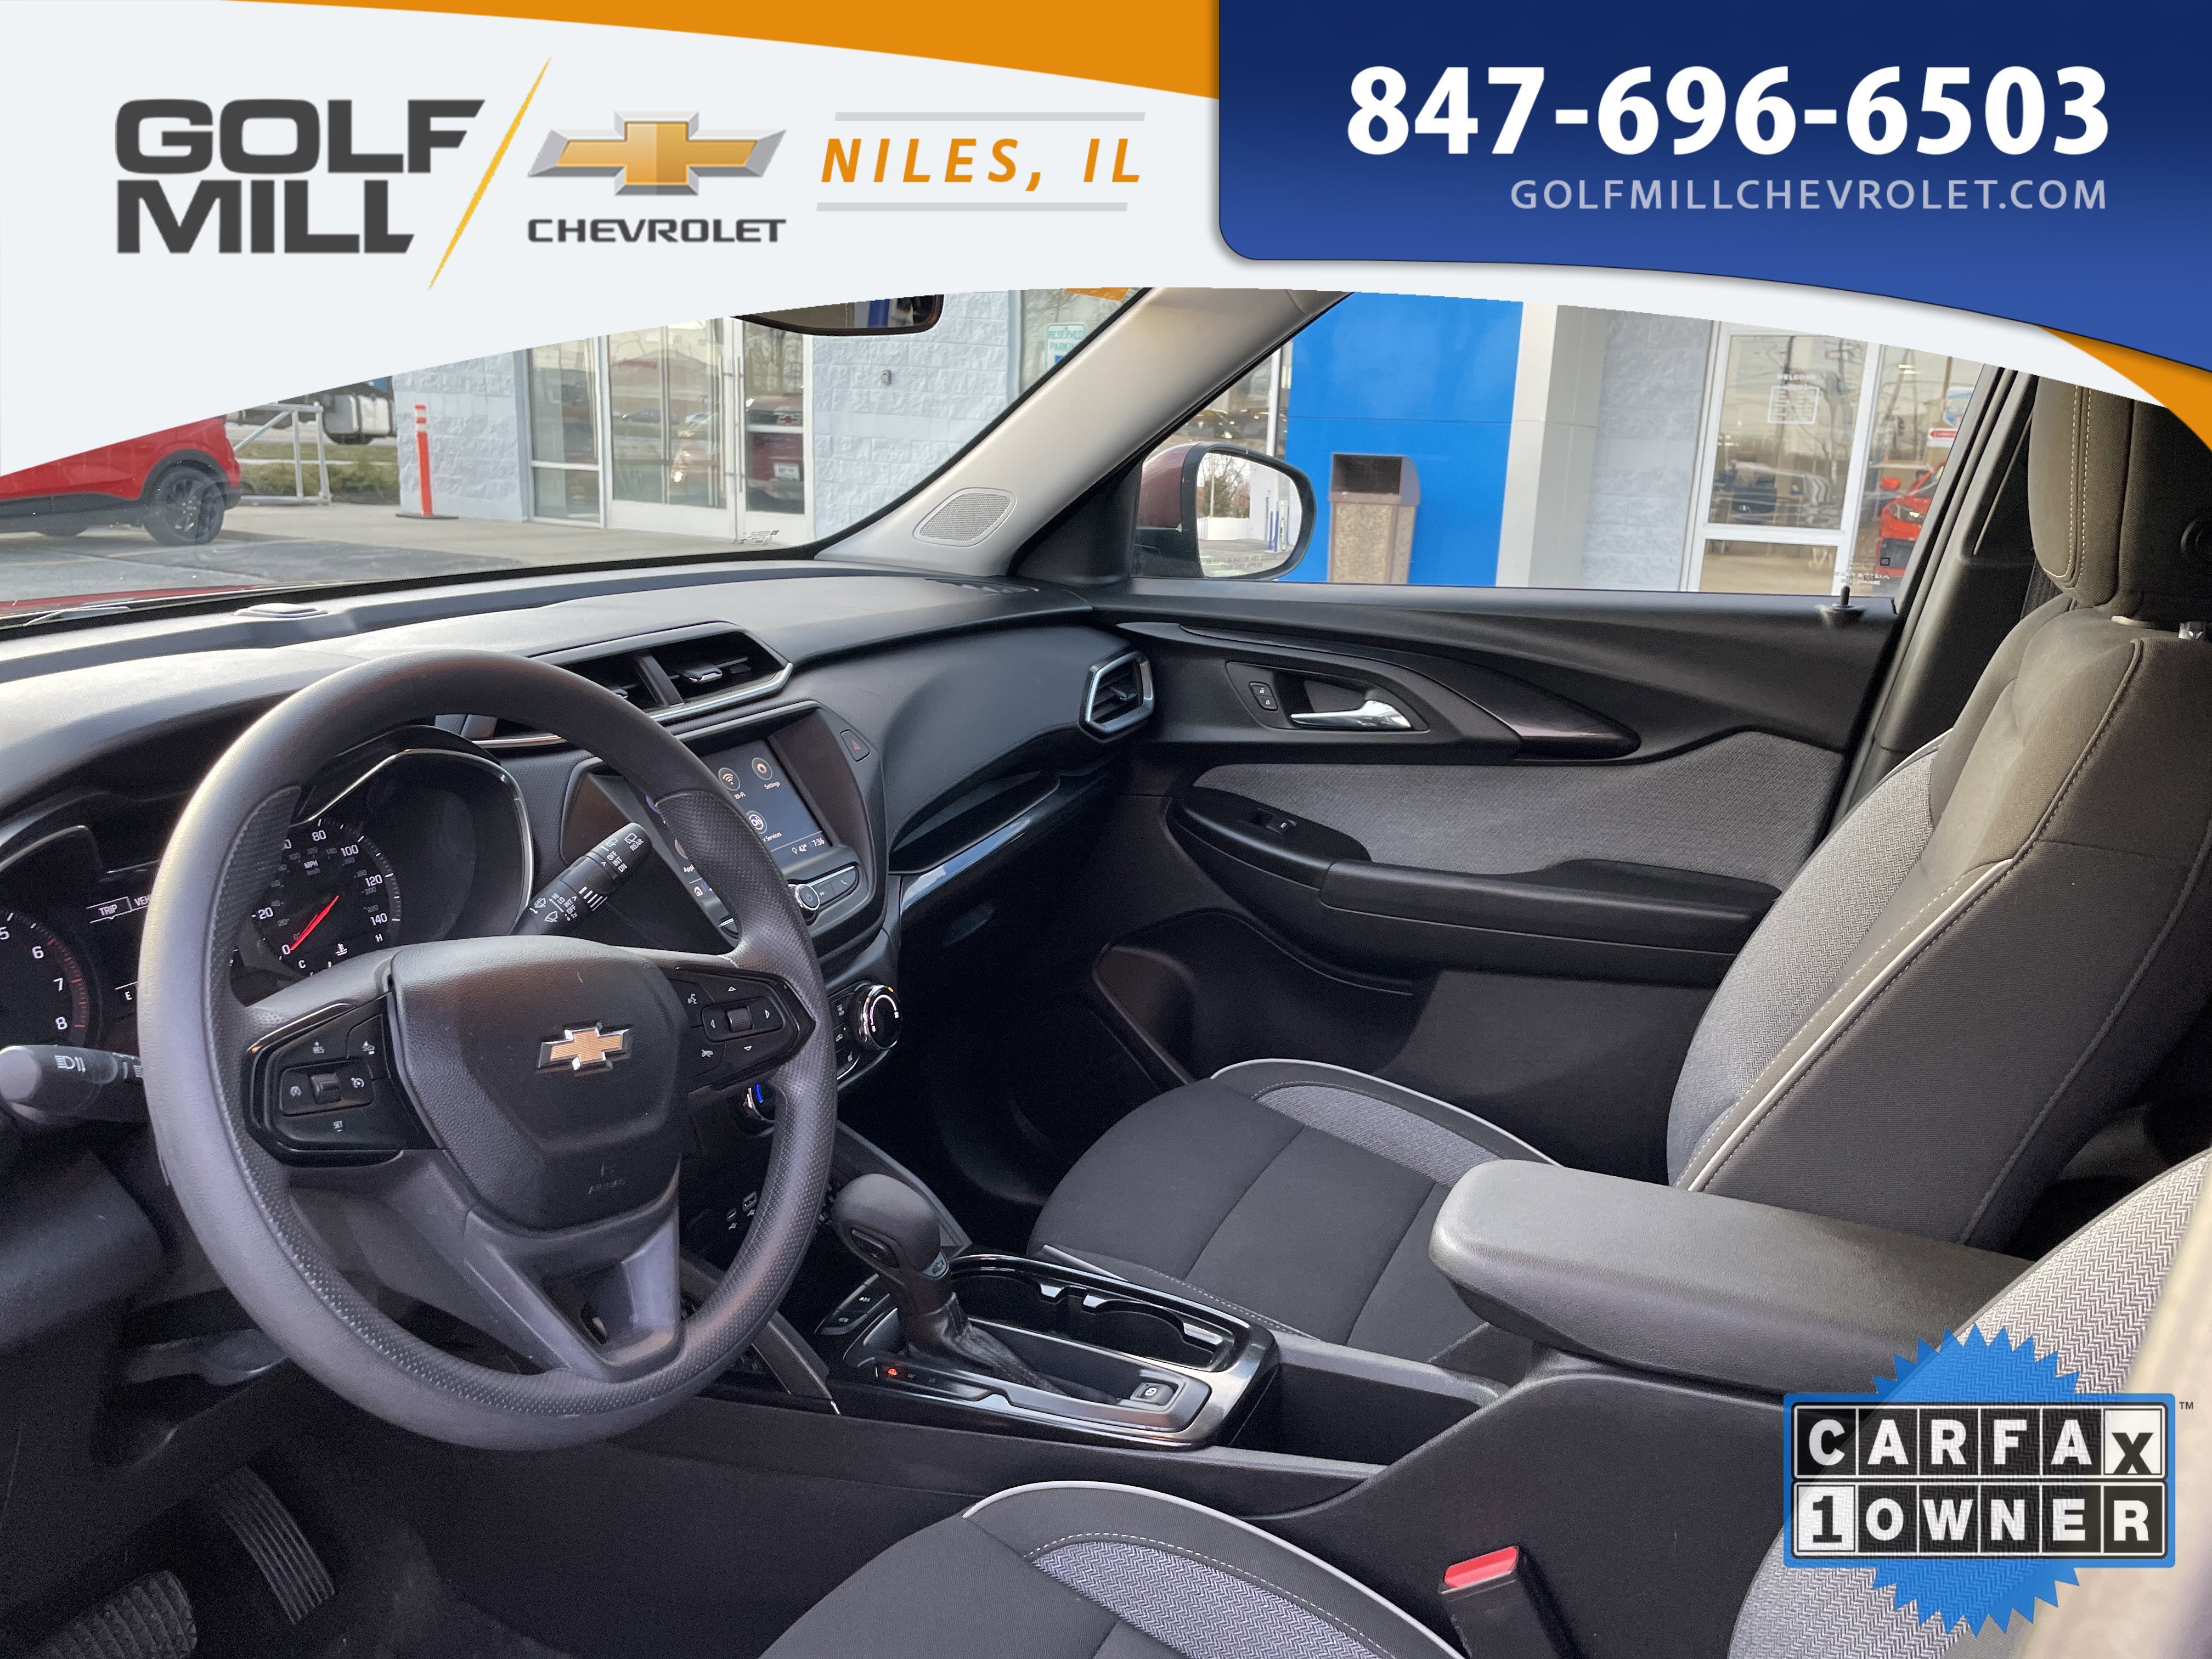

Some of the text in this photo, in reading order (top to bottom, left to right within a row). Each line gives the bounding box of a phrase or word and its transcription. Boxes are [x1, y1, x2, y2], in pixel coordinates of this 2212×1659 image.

[764, 781, 781, 790] Settings
[312, 830, 326, 842] 80
[765, 832, 782, 842] Services
[629, 838, 644, 851] REAR
[341, 844, 359, 857] 100
[607, 850, 617, 861] OFF
[612, 856, 623, 867] INT
[618, 863, 628, 872] ON
[683, 864, 695, 873] Appl
[365, 874, 383, 887] 120
[98, 895, 151, 916] TRIP VEH
[563, 898, 573, 908] INT
[258, 907, 274, 920] 20
[566, 904, 576, 915] OFF
[370, 912, 388, 927] 140
[375, 933, 383, 943] H
[32, 946, 44, 959] 6
[281, 944, 291, 955] 0
[298, 960, 306, 969] C
[53, 977, 64, 991] 7
[125, 991, 133, 1001] E
[55, 1017, 68, 1030] 8
